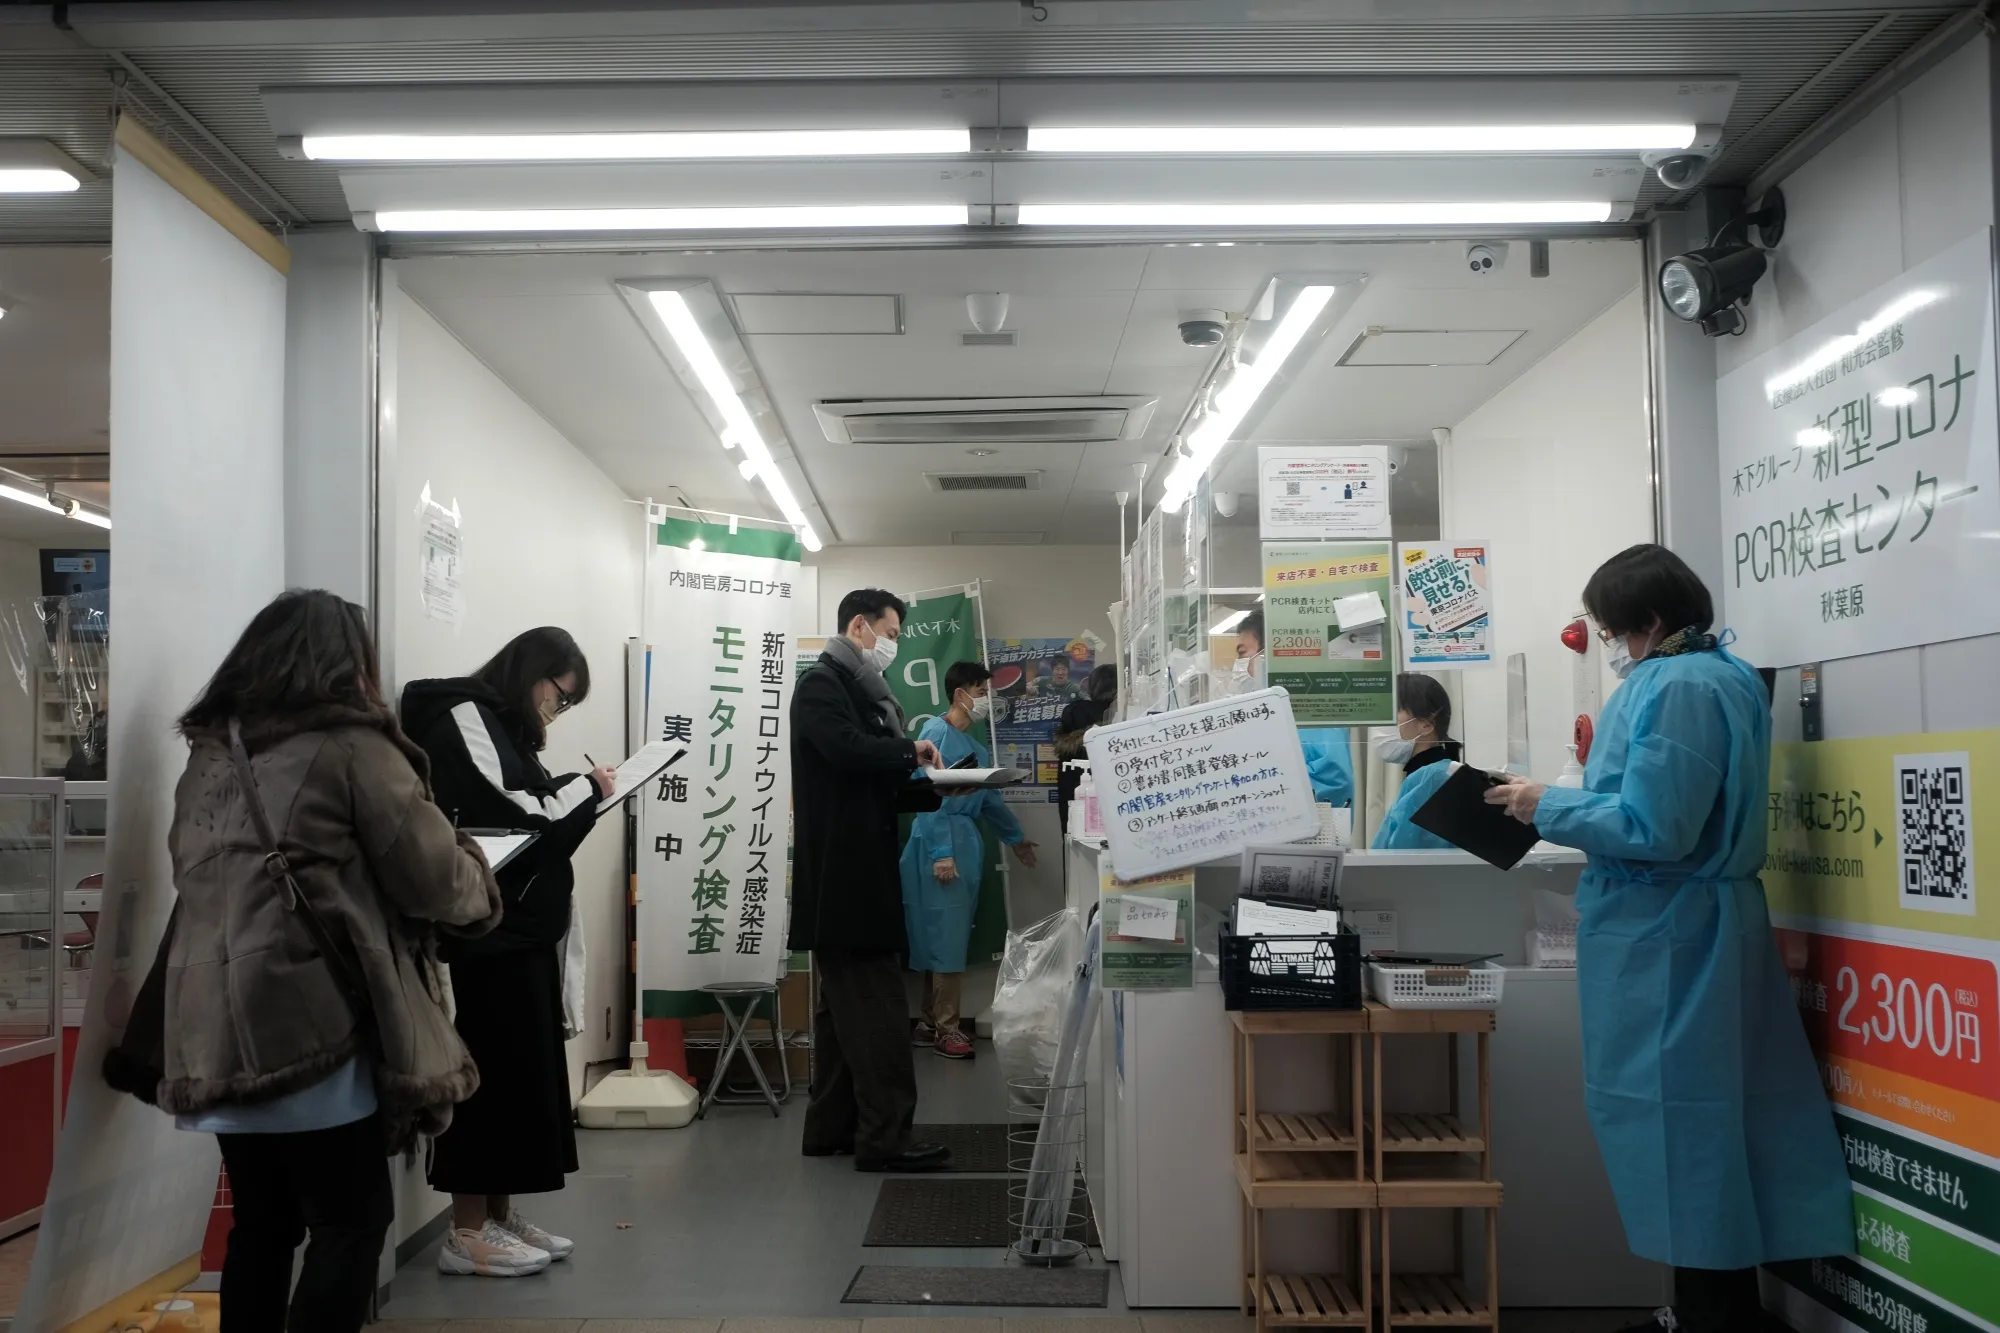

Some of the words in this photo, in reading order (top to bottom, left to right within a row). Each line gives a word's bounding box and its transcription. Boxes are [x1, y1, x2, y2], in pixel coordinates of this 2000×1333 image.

[1732, 445, 1803, 498] 木下グループ
[1812, 354, 1976, 483] 新型コロナ
[1735, 470, 1979, 589] PCR検査センター
[669, 569, 792, 599] 内閣官房コロナ室
[1276, 562, 1379, 582] 来店不要・自宅で検査
[1408, 557, 1470, 592] 飲む前に、
[1422, 569, 1473, 608] 見せる!
[1271, 597, 1331, 606] PCR検査キット
[1821, 584, 1864, 623] 秋葉原
[1271, 628, 1321, 636] PCR検査キット
[1014, 694, 1061, 708] ジュニアコース
[1107, 702, 1276, 755] 受付にて、下記を提示願います。
[687, 625, 746, 956] モニタリング検査
[736, 631, 786, 956] 新型コロナウイルス感染症
[1270, 953, 1315, 963] ULTIMATE
[1836, 965, 1981, 1064] 2,300円
[1842, 1133, 1969, 1211] 方は検査できません
[1856, 1212, 1911, 1264] よる検査
[1812, 1258, 1929, 1333] 検査時間は3分程度
